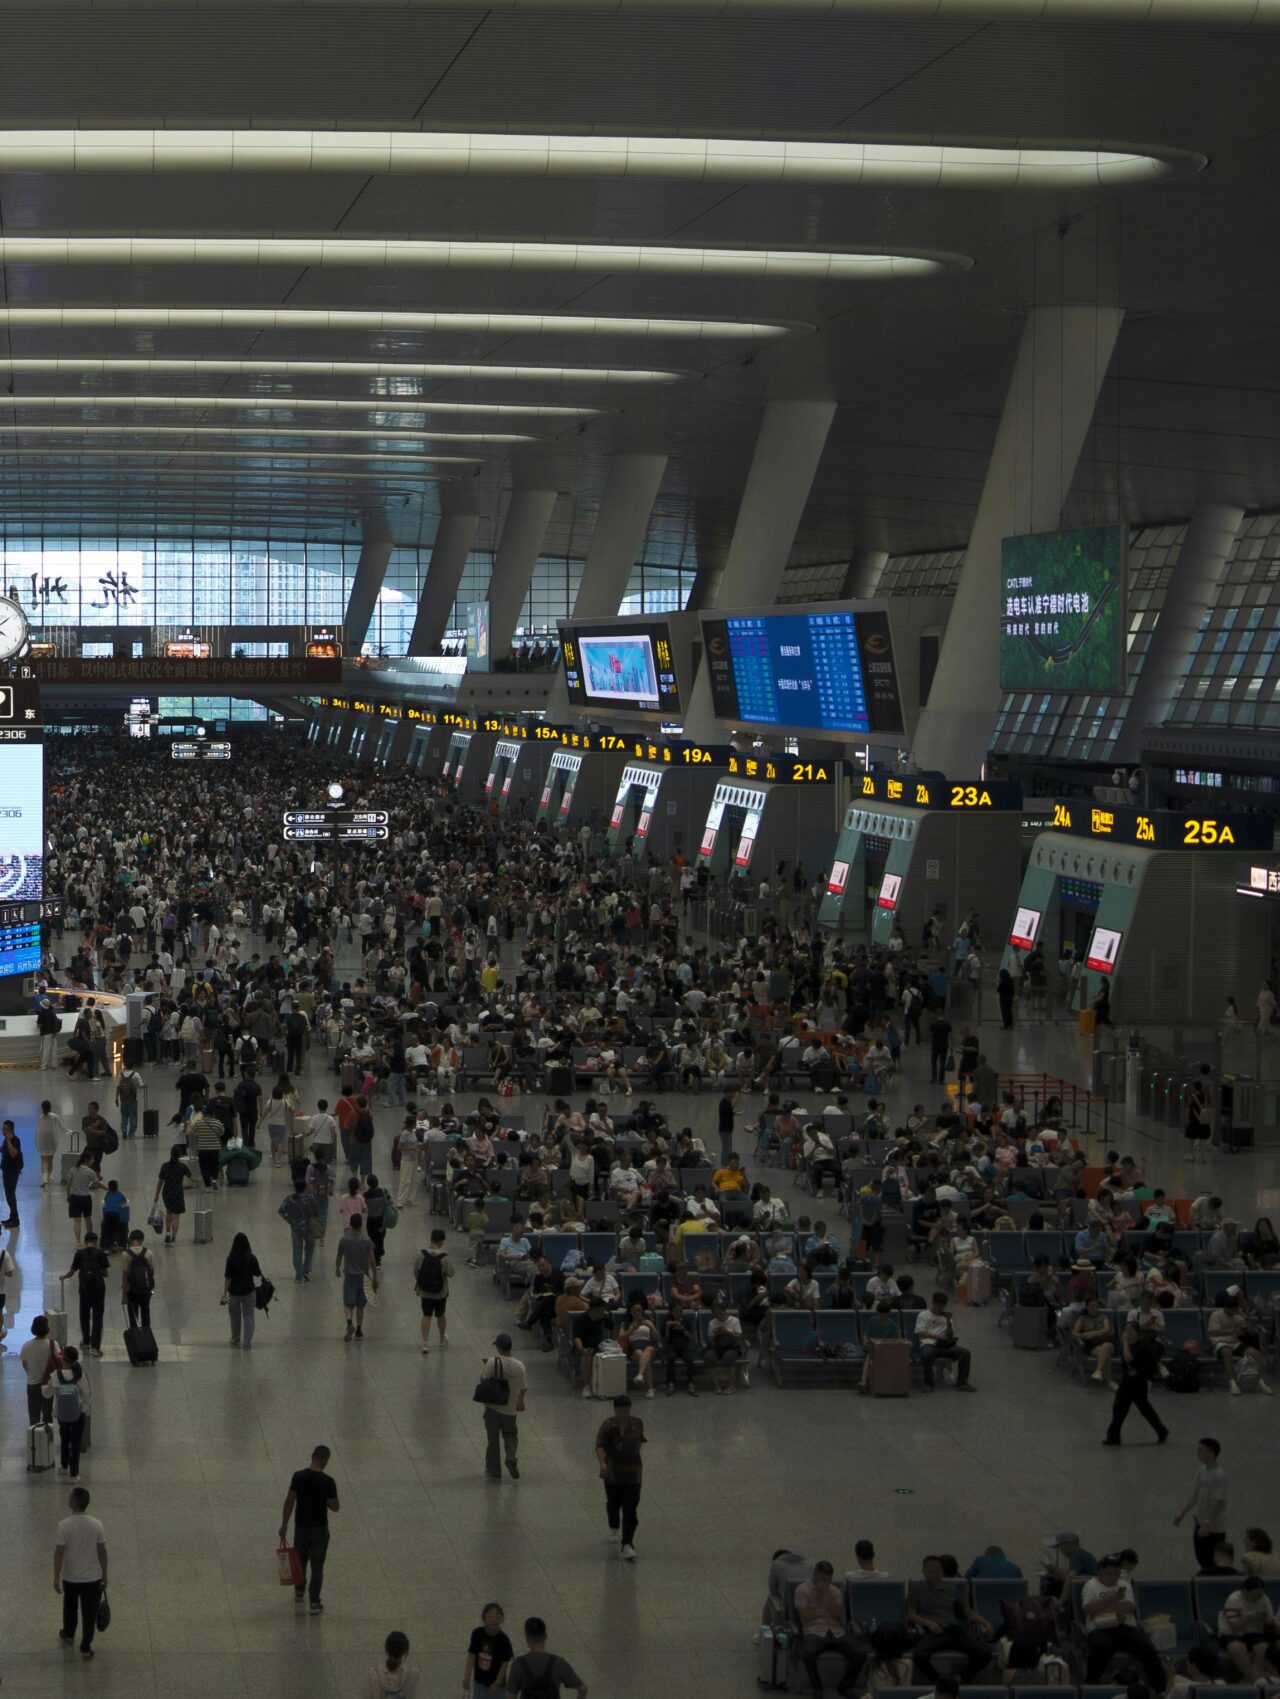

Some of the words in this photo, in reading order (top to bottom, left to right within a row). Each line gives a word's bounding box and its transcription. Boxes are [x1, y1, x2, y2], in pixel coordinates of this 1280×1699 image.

[1006, 592, 1089, 616] 选电车认准宁德时代电池
[24, 708, 36, 720] 东
[380, 705, 391, 714] 7A
[408, 709, 420, 719] 9A
[443, 714, 461, 725] 11A
[535, 727, 558, 739] 15A
[599, 737, 625, 749] 17A
[682, 748, 712, 763] 19A
[793, 764, 827, 781] 21A
[863, 776, 875, 795] 22A
[916, 785, 929, 804] 23A
[950, 787, 992, 806] 23A
[1053, 804, 1072, 828] 24A
[1136, 816, 1155, 841] 25A
[1183, 820, 1235, 844] 25A
